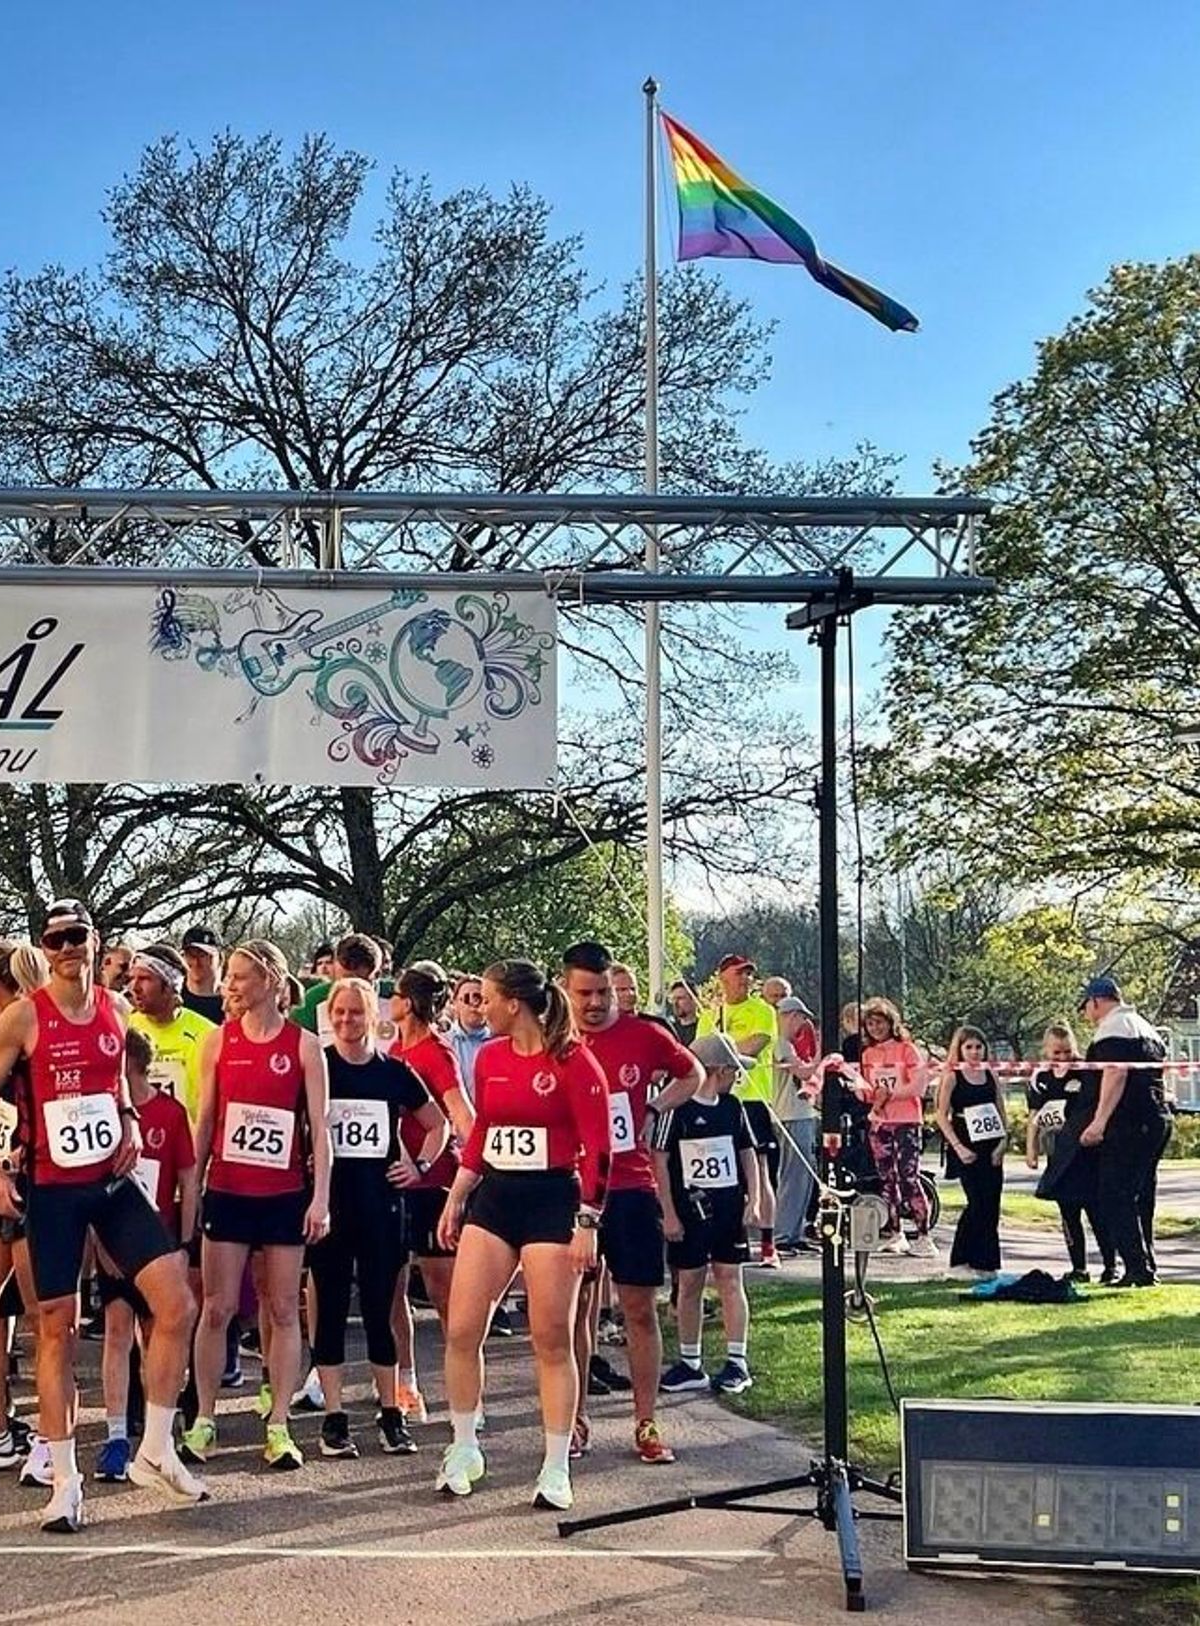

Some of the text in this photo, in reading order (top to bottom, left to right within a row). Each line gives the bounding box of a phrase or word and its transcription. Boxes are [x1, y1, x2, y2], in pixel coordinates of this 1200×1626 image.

[59, 1120, 113, 1154] 316
[232, 1125, 284, 1155] 425
[331, 1121, 380, 1147] 184
[491, 1129, 536, 1156] 413
[691, 1156, 731, 1179] 281
